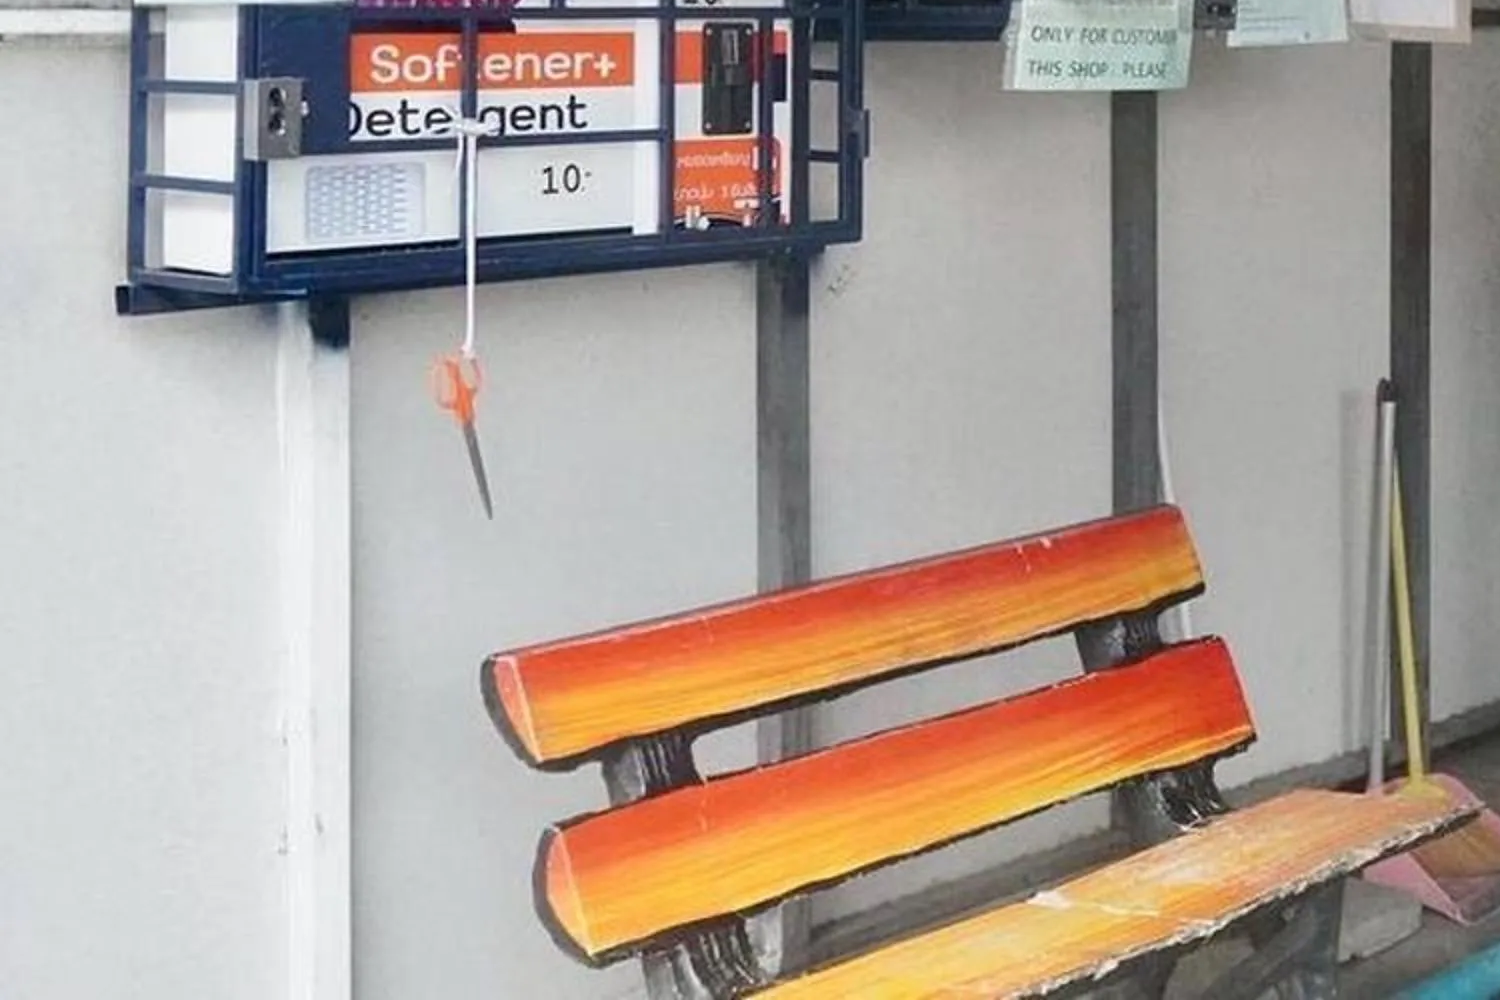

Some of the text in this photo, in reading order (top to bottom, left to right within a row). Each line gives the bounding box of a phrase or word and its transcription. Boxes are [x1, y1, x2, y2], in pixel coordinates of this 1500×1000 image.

[1031, 24, 1074, 43] ONLY
[1079, 26, 1108, 44] FOR
[370, 42, 617, 84] Sofener+
[1027, 59, 1063, 78] THIS
[1122, 61, 1168, 80] PLEASE
[350, 94, 588, 138] etegent
